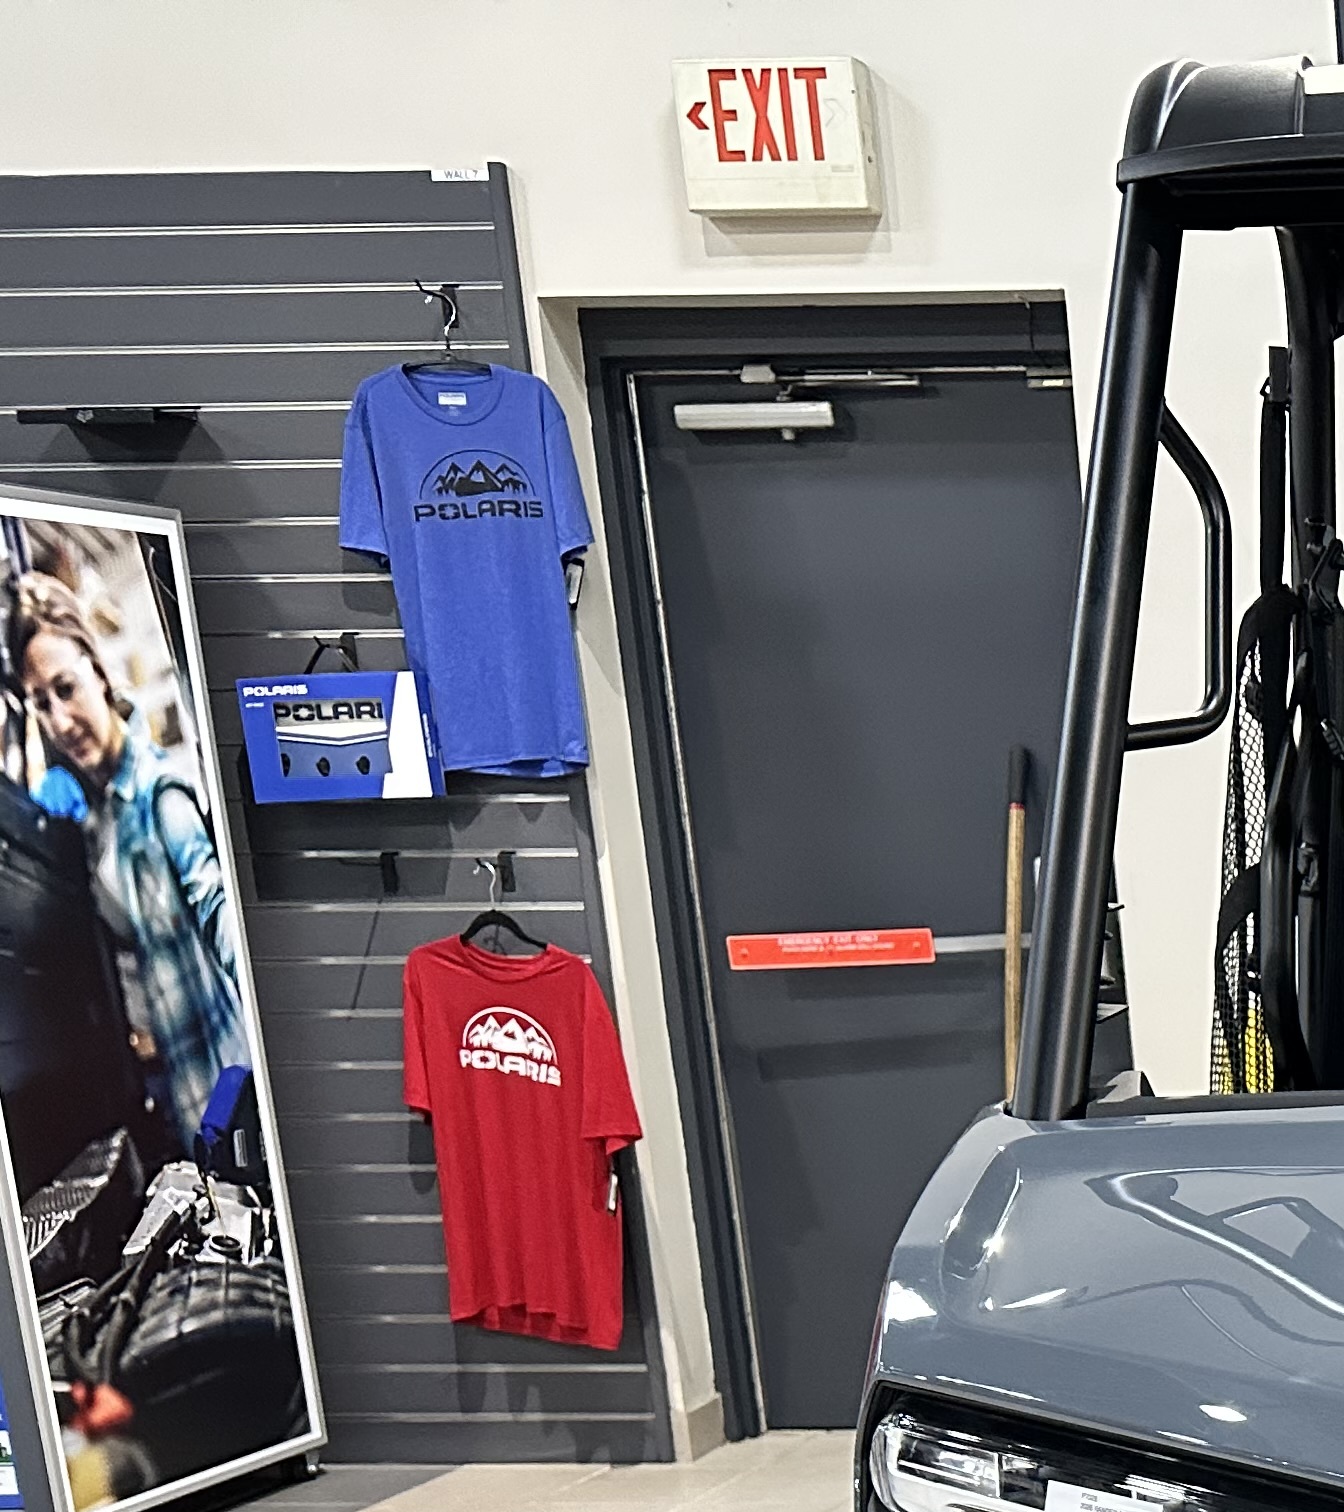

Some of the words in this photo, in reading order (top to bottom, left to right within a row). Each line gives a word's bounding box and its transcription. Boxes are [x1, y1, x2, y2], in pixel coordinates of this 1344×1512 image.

[707, 67, 827, 162] EXIT
[413, 500, 543, 522] POLARIS
[243, 685, 308, 697] POLARIS
[459, 1049, 561, 1087] POLARIS
